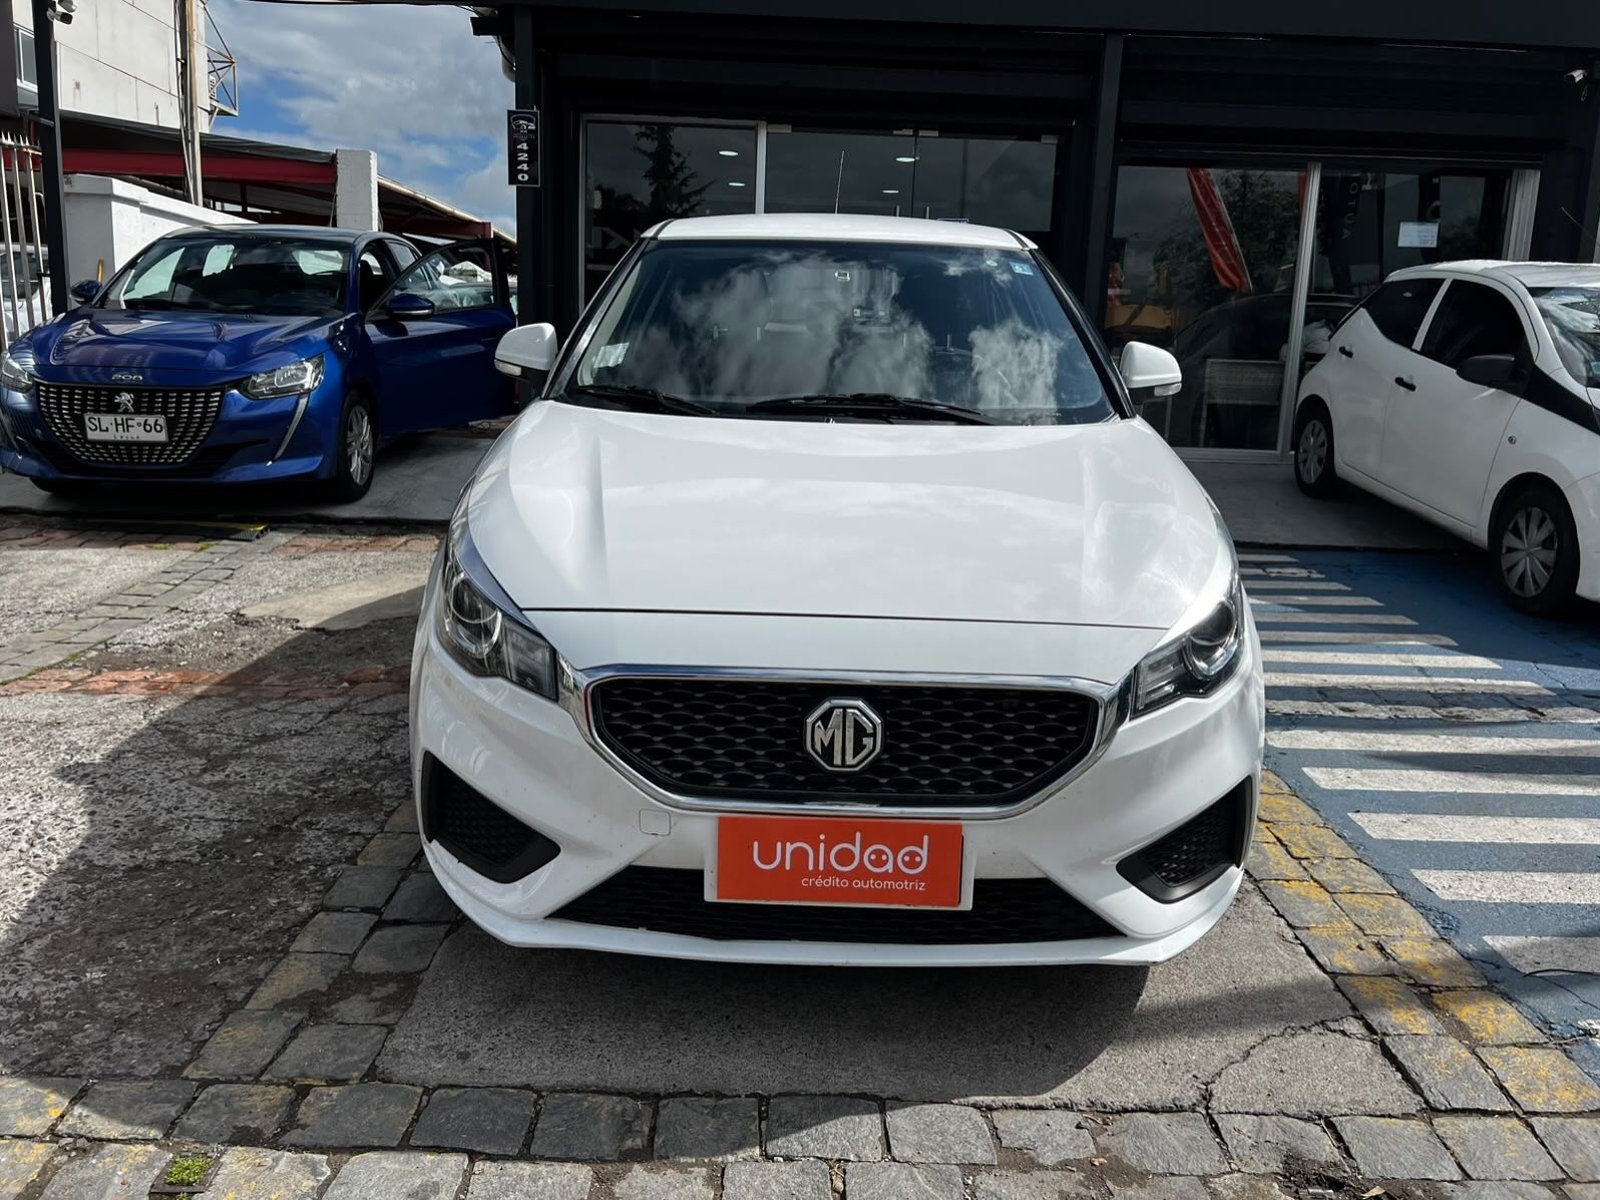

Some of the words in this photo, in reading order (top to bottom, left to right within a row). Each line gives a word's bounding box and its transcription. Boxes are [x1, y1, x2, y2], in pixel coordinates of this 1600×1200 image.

[517, 142, 529, 181] 4240
[813, 708, 874, 766] MG
[753, 831, 929, 875] unidad
[801, 875, 849, 888] crédito
[852, 878, 926, 891] automotriz
